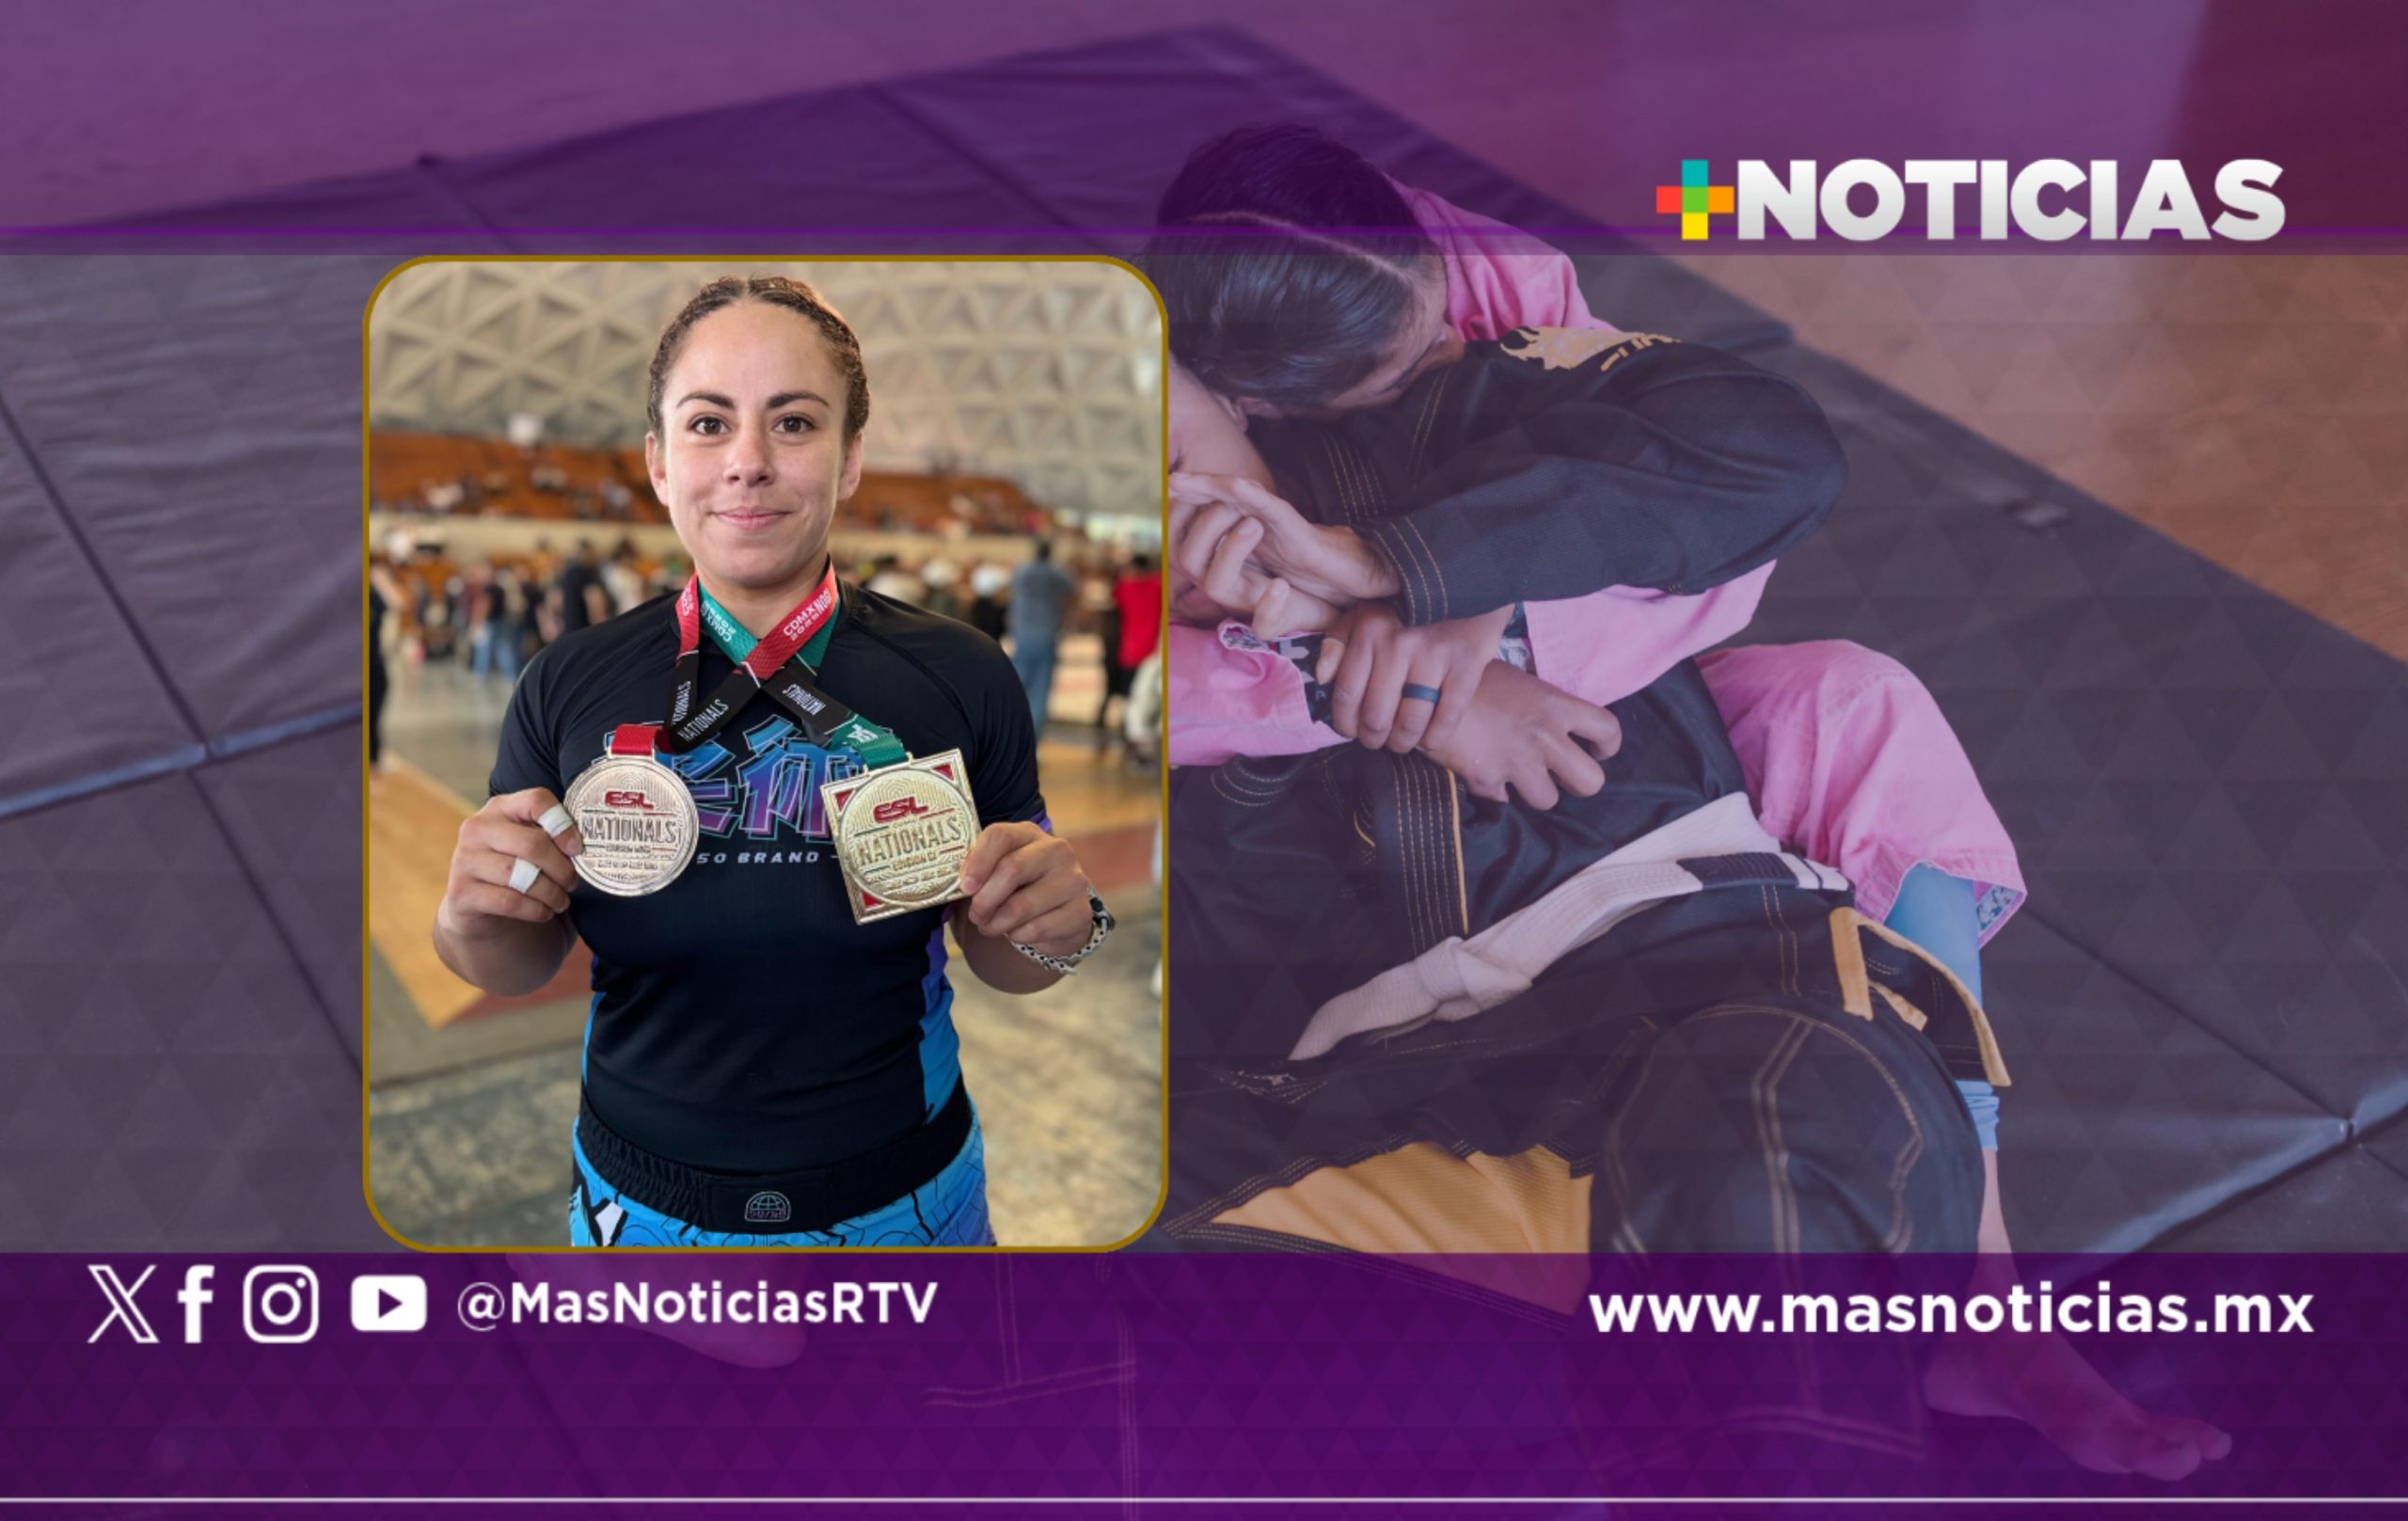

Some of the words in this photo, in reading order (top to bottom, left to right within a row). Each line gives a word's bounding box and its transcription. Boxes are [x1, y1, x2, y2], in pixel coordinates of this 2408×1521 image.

[783, 604, 816, 637] CDMX
[677, 699, 729, 742] NATIONALS
[605, 791, 655, 810] ESL
[873, 796, 929, 823] ESL
[581, 815, 677, 845] NATIONALS
[856, 816, 961, 866] NATIONALS
[737, 851, 820, 863] BRAND
